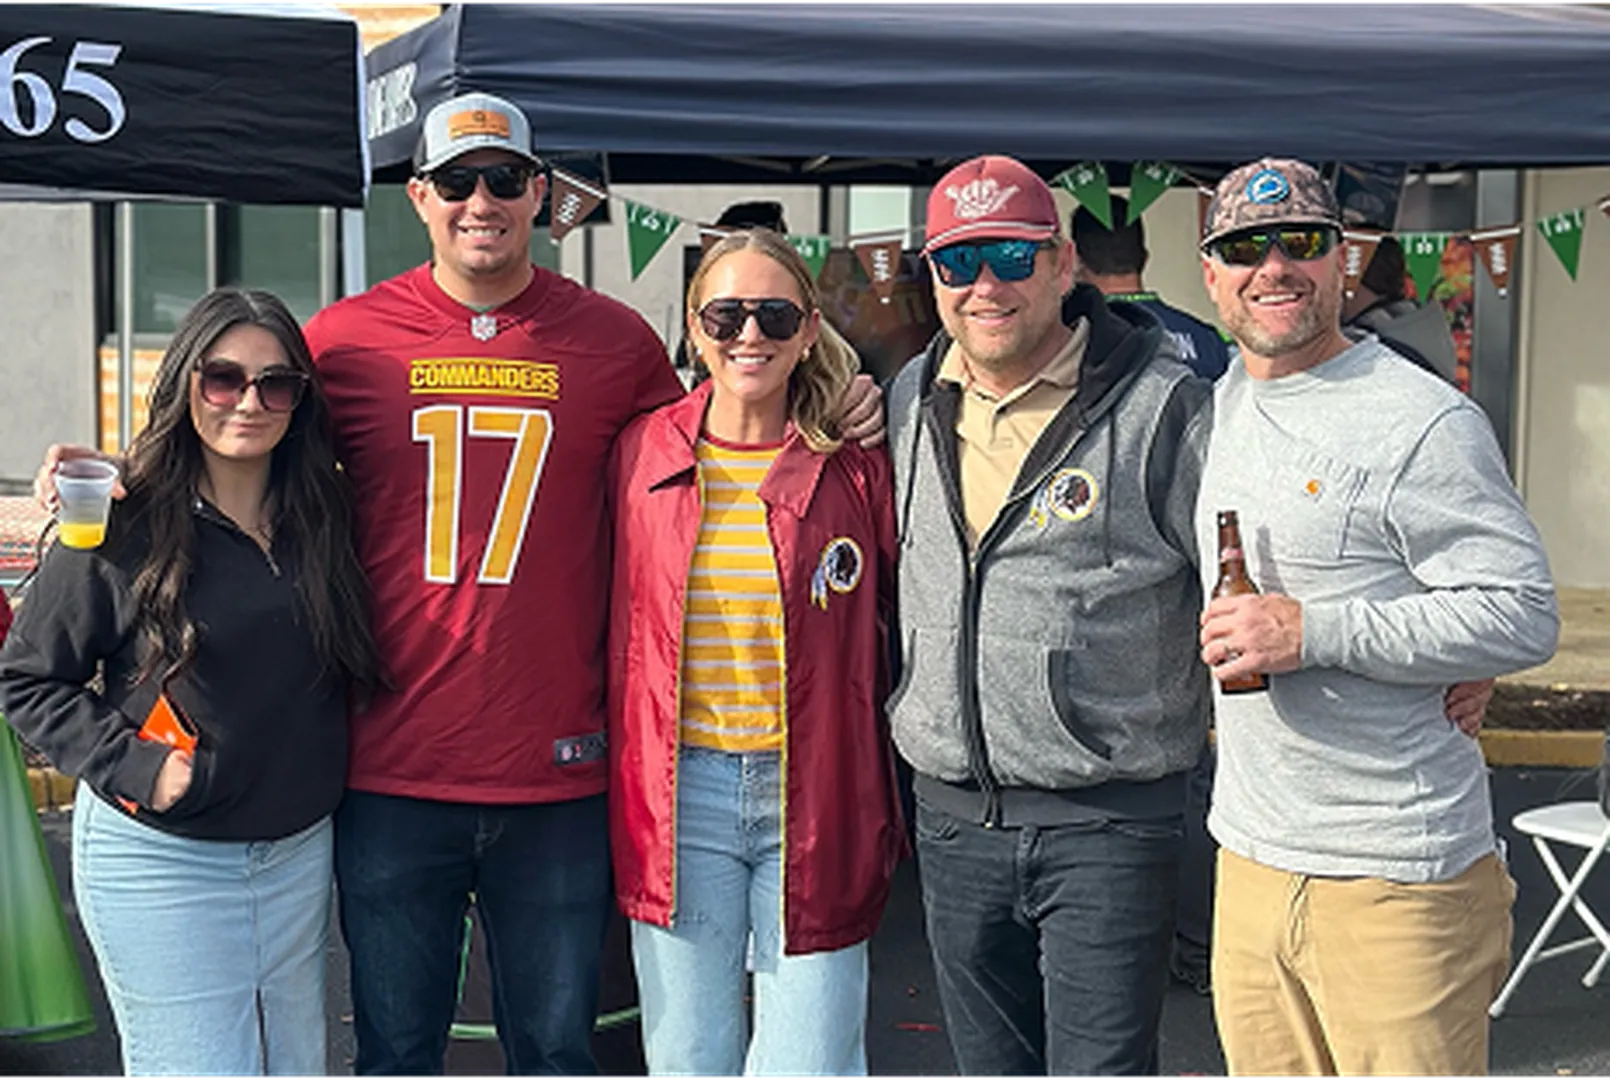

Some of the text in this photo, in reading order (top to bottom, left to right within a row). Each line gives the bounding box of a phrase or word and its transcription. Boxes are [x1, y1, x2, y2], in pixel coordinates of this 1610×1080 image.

[0, 37, 125, 141] 65
[410, 363, 559, 394] COMMANDERS
[412, 405, 553, 584] 17
